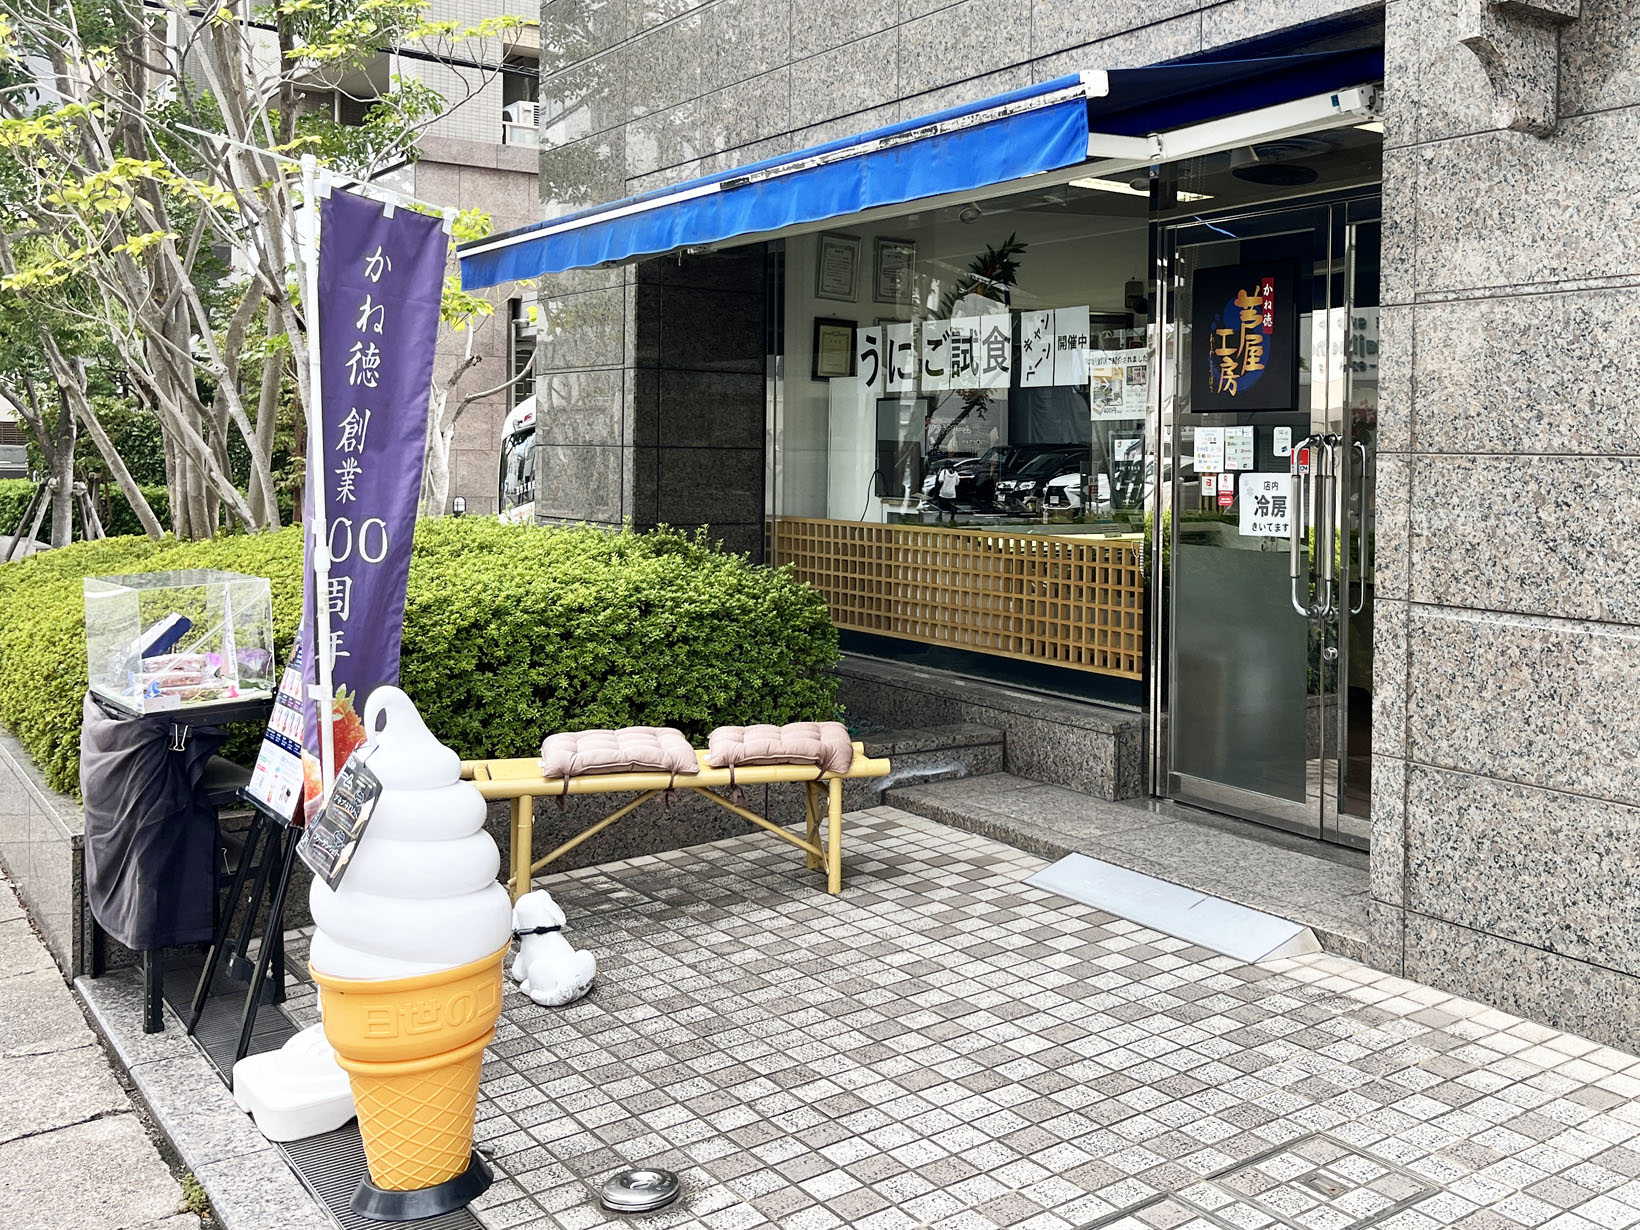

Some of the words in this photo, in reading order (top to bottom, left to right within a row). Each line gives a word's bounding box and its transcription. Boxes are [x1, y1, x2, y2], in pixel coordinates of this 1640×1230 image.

[344, 245, 391, 389] かね徳
[1262, 283, 1274, 328] かね徳
[1057, 333, 1087, 351] 開催中
[1234, 285, 1264, 376] 芦屋
[860, 325, 1010, 387] うにご試食
[1214, 328, 1240, 397] 工房
[1253, 495, 1287, 518] 冷房
[1263, 481, 1279, 491] 店内
[1251, 522, 1289, 533] きいてます
